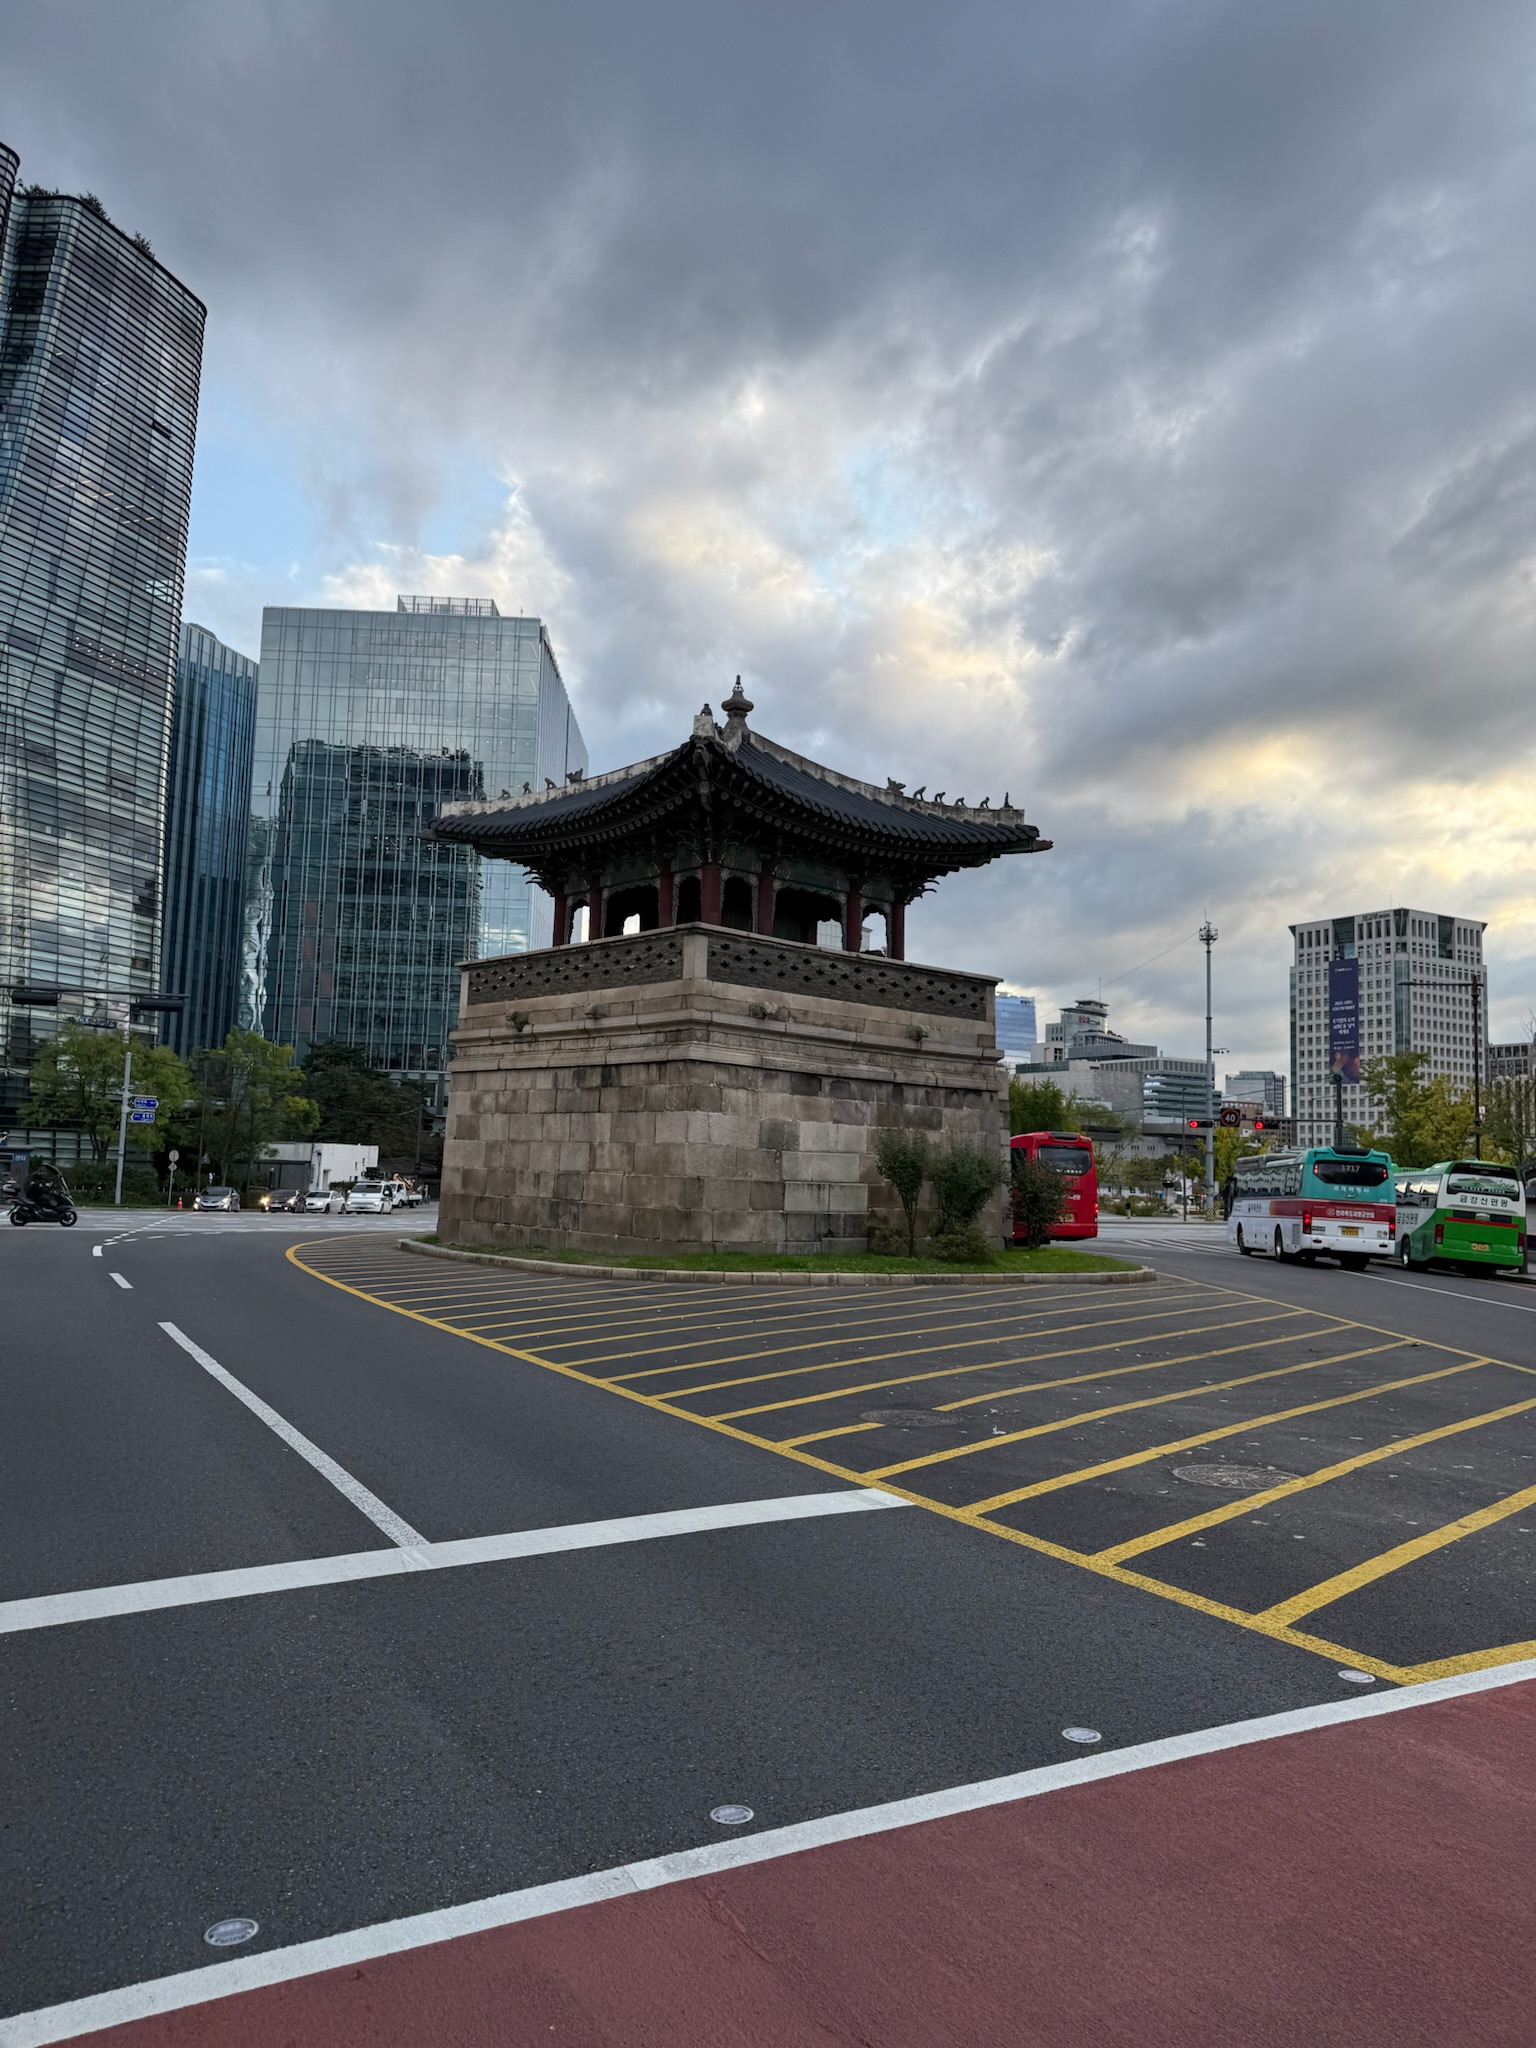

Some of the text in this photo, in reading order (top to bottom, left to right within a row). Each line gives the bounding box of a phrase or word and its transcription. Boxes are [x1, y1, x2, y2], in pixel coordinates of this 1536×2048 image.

[1225, 1113, 1236, 1122] 40
[1341, 1164, 1360, 1172] 1717
[1460, 1195, 1508, 1208] 금강산관광
